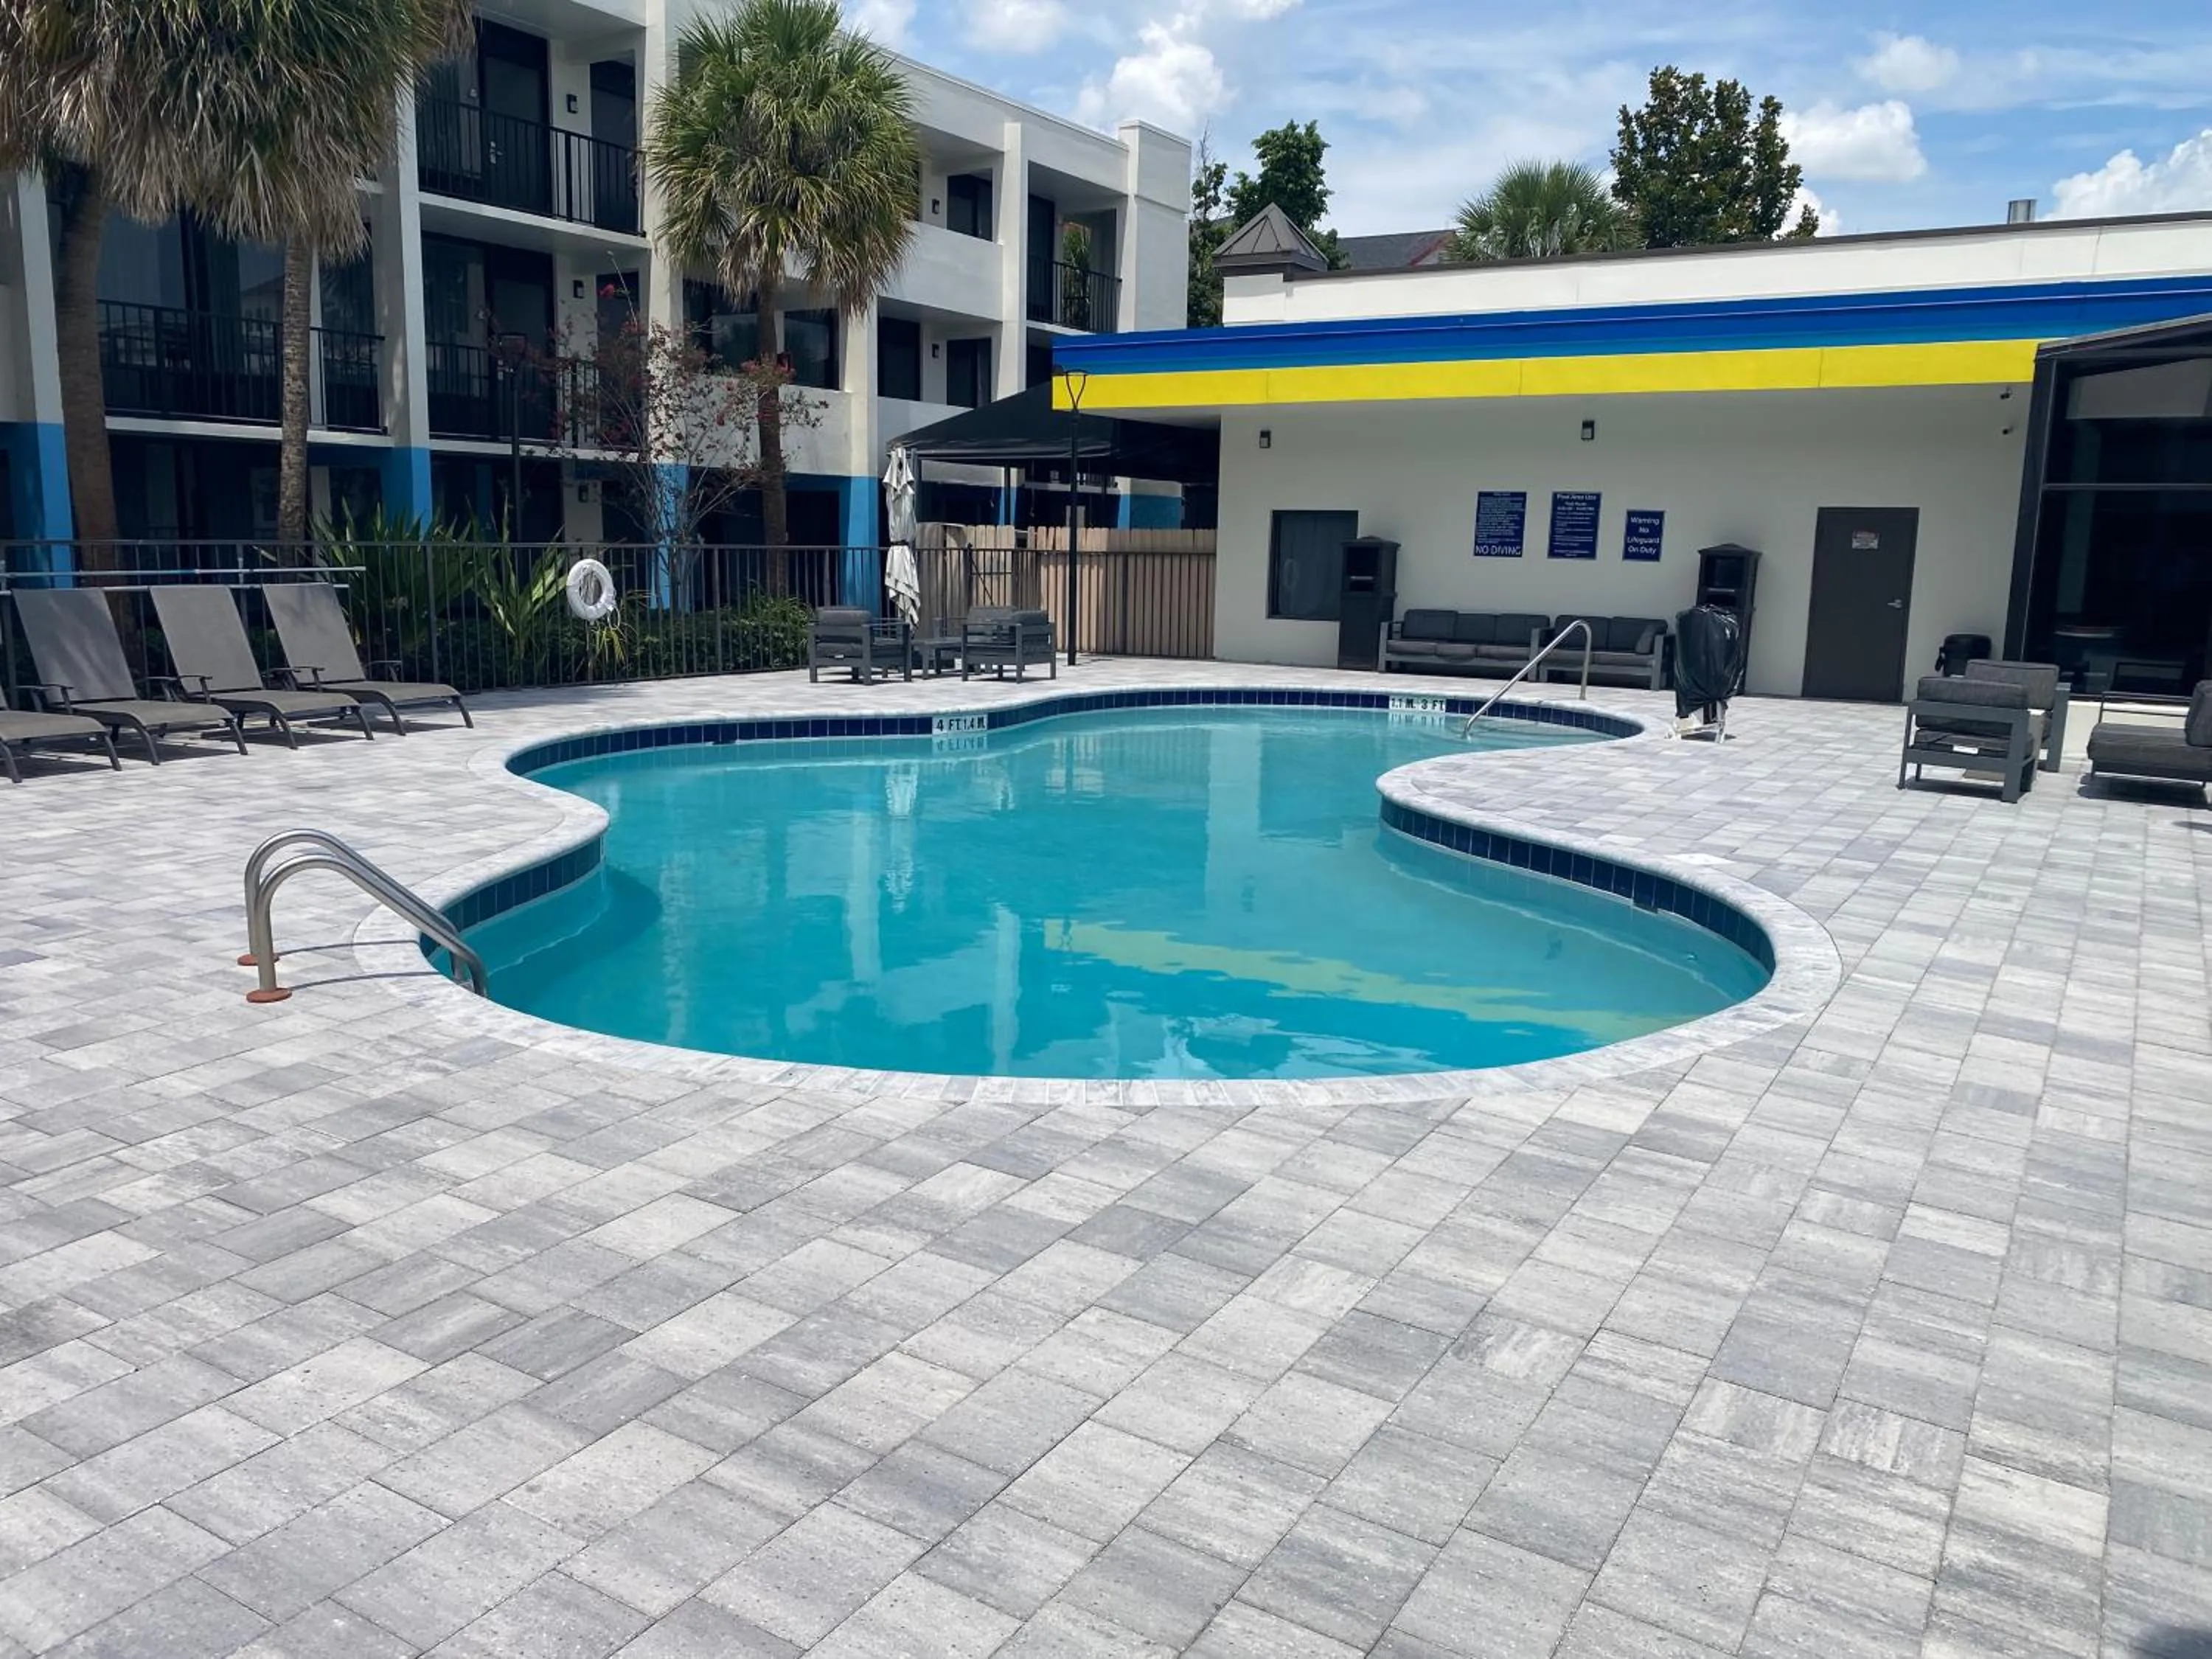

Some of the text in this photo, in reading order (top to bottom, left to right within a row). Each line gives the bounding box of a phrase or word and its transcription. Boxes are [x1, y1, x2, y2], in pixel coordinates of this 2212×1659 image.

[1630, 517, 1659, 525] Warning
[1475, 545, 1521, 555] NO DIVING
[1639, 546, 1656, 554] Duty
[1421, 699, 1428, 710] 3
[936, 719, 944, 732] 4
